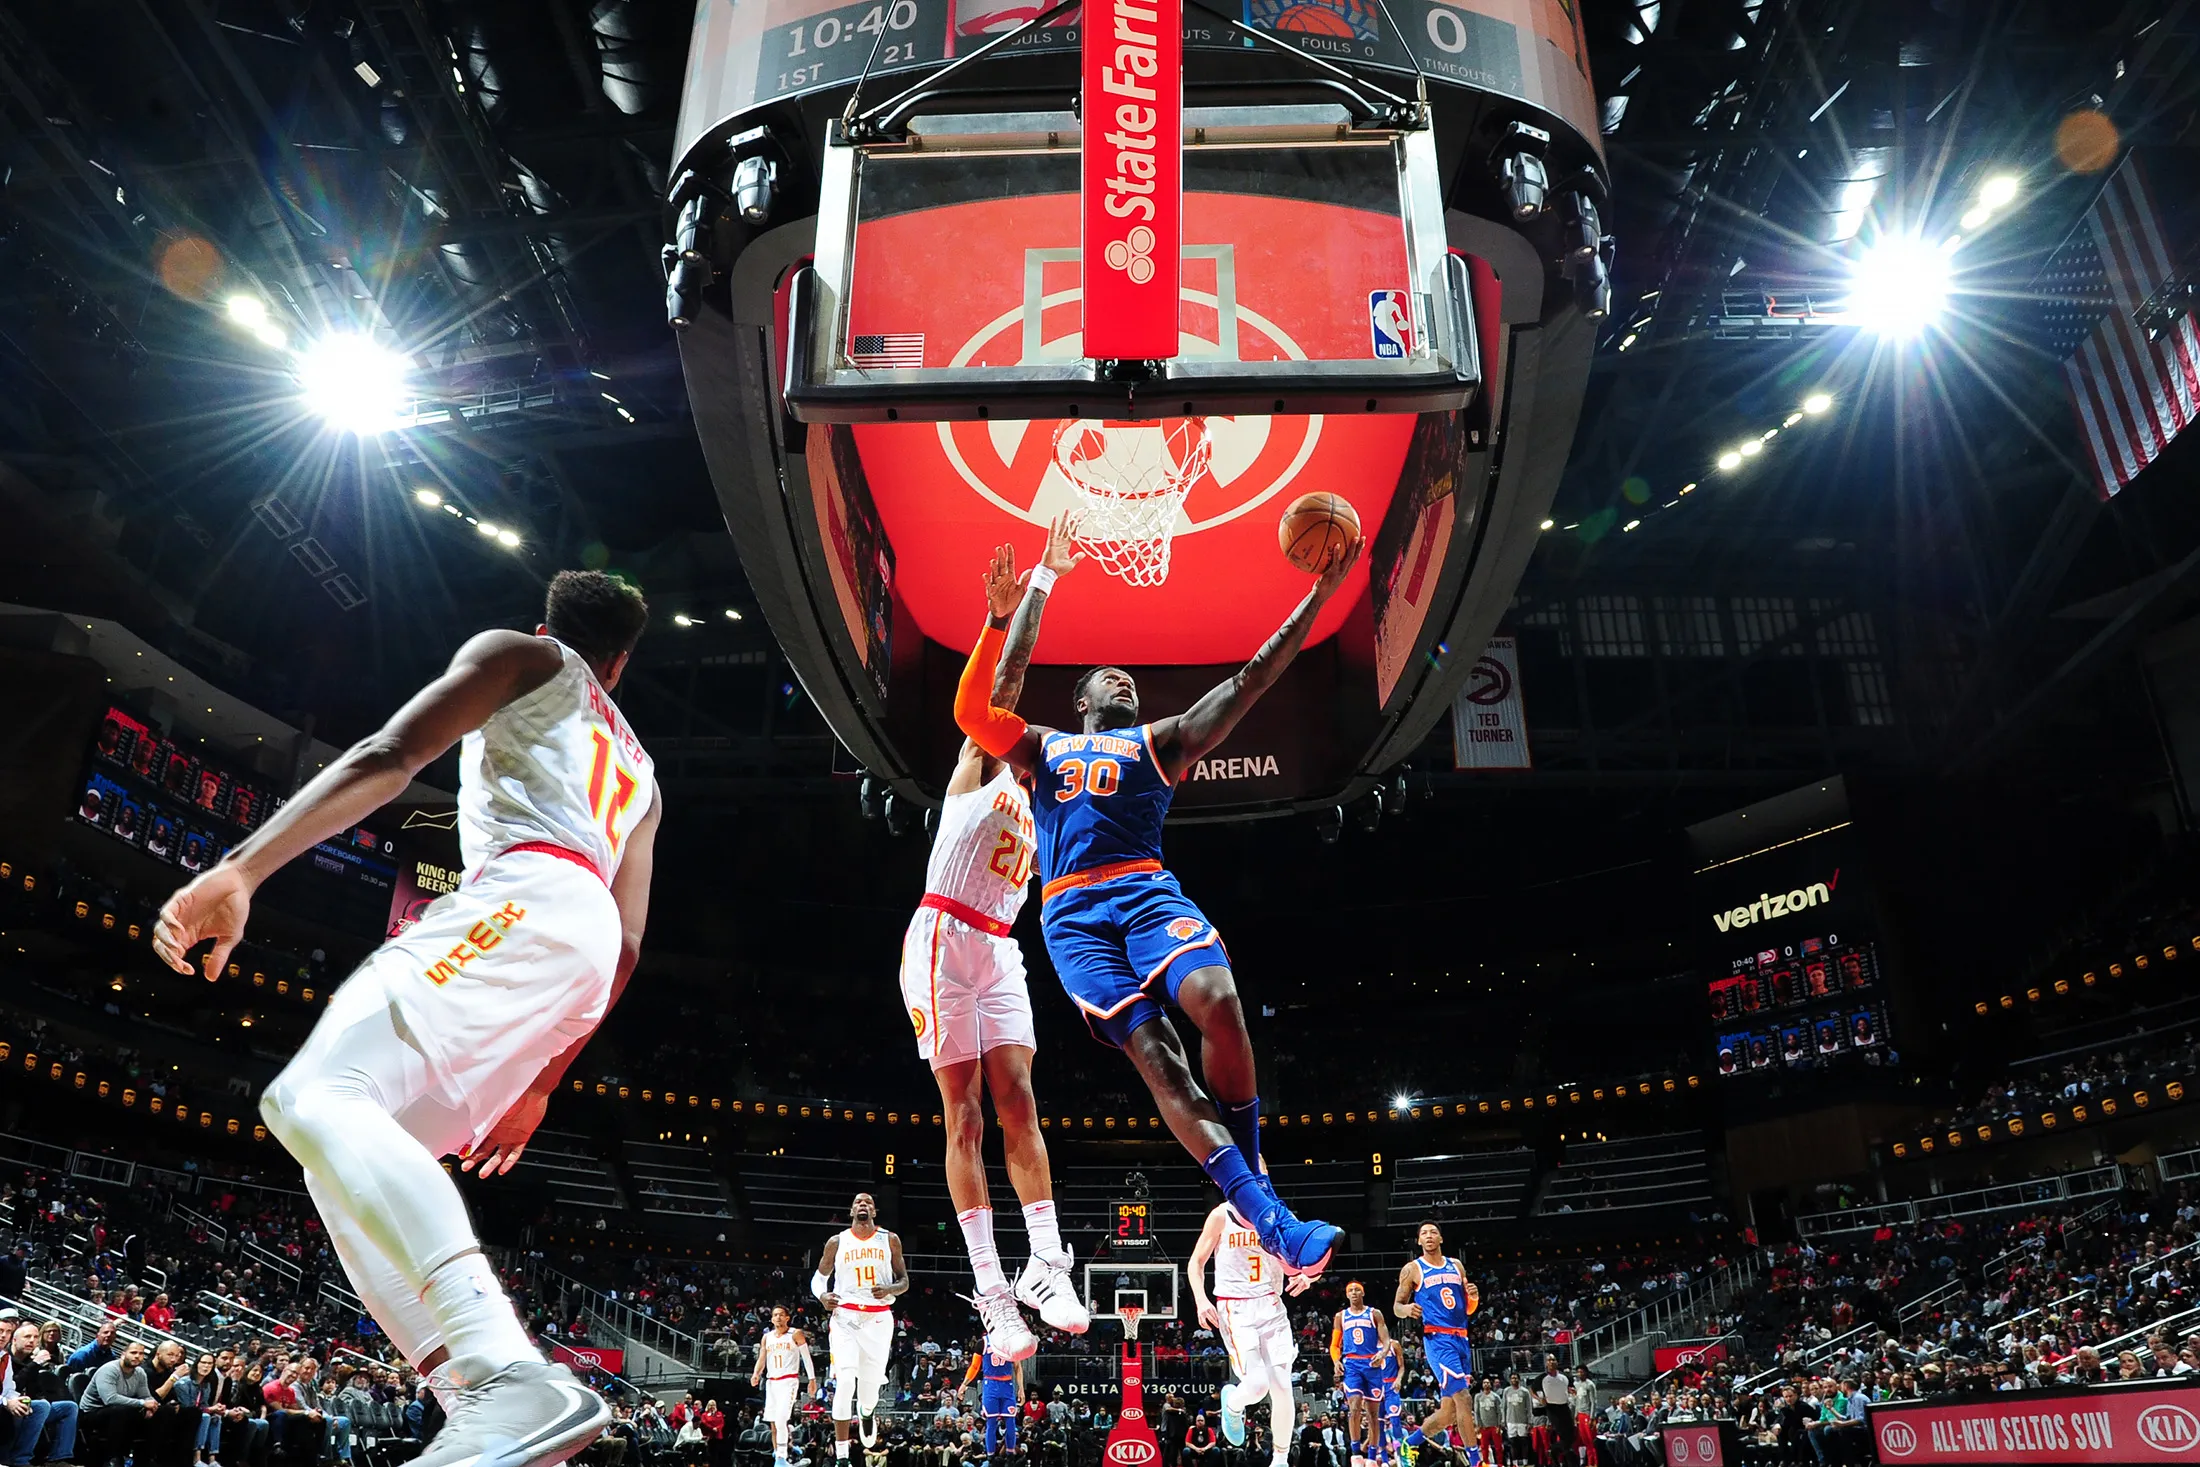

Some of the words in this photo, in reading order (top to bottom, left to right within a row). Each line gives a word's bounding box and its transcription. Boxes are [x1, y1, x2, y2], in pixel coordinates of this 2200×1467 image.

[787, 0, 918, 58] 10:40
[1011, 30, 1053, 46] ULS
[1066, 30, 1077, 42] 0
[1228, 30, 1236, 42] 7
[1425, 8, 1467, 54] 0
[1302, 36, 1351, 54] FOULS
[1364, 45, 1374, 57] 0
[776, 62, 824, 91] 1ST
[883, 41, 916, 65] 21
[1423, 57, 1496, 86] TIMEOUTS
[1378, 344, 1399, 355] NBA
[587, 680, 644, 765] HNTER
[1478, 713, 1500, 726] TED
[1468, 729, 1514, 743] TURNER
[1046, 735, 1089, 762] NEW
[1091, 735, 1142, 761] YORK
[1193, 755, 1280, 781] ARENA
[1055, 758, 1121, 803] 30
[384, 841, 394, 853] 0
[989, 827, 1029, 891] 20
[416, 861, 446, 880] KING
[417, 875, 455, 894] BEERS
[1713, 881, 1830, 933] verizon
[1828, 933, 1838, 945] 0
[1784, 945, 1793, 957] 0
[1732, 956, 1755, 969] 10:40
[1119, 1205, 1146, 1217] 10:40
[1118, 1217, 1145, 1236] 21
[844, 1247, 885, 1264] ATLANTA
[855, 1266, 876, 1287] 14
[1248, 1255, 1261, 1282] 3
[1440, 1287, 1456, 1310] 6
[1352, 1328, 1365, 1345] 9
[774, 1354, 783, 1369] 11
[1681, 1354, 1694, 1364] KI
[1068, 1384, 1119, 1394] DELTA
[1886, 1428, 1912, 1449] KIA
[1931, 1418, 1999, 1453] ALL-NEW
[2000, 1413, 2070, 1451] SELTOS
[2071, 1411, 2113, 1450] SUV
[2145, 1414, 2193, 1442] KIA
[1115, 1445, 1148, 1460] KIA
[1675, 1443, 1687, 1456] KIA
[1700, 1440, 1714, 1456] KIA
